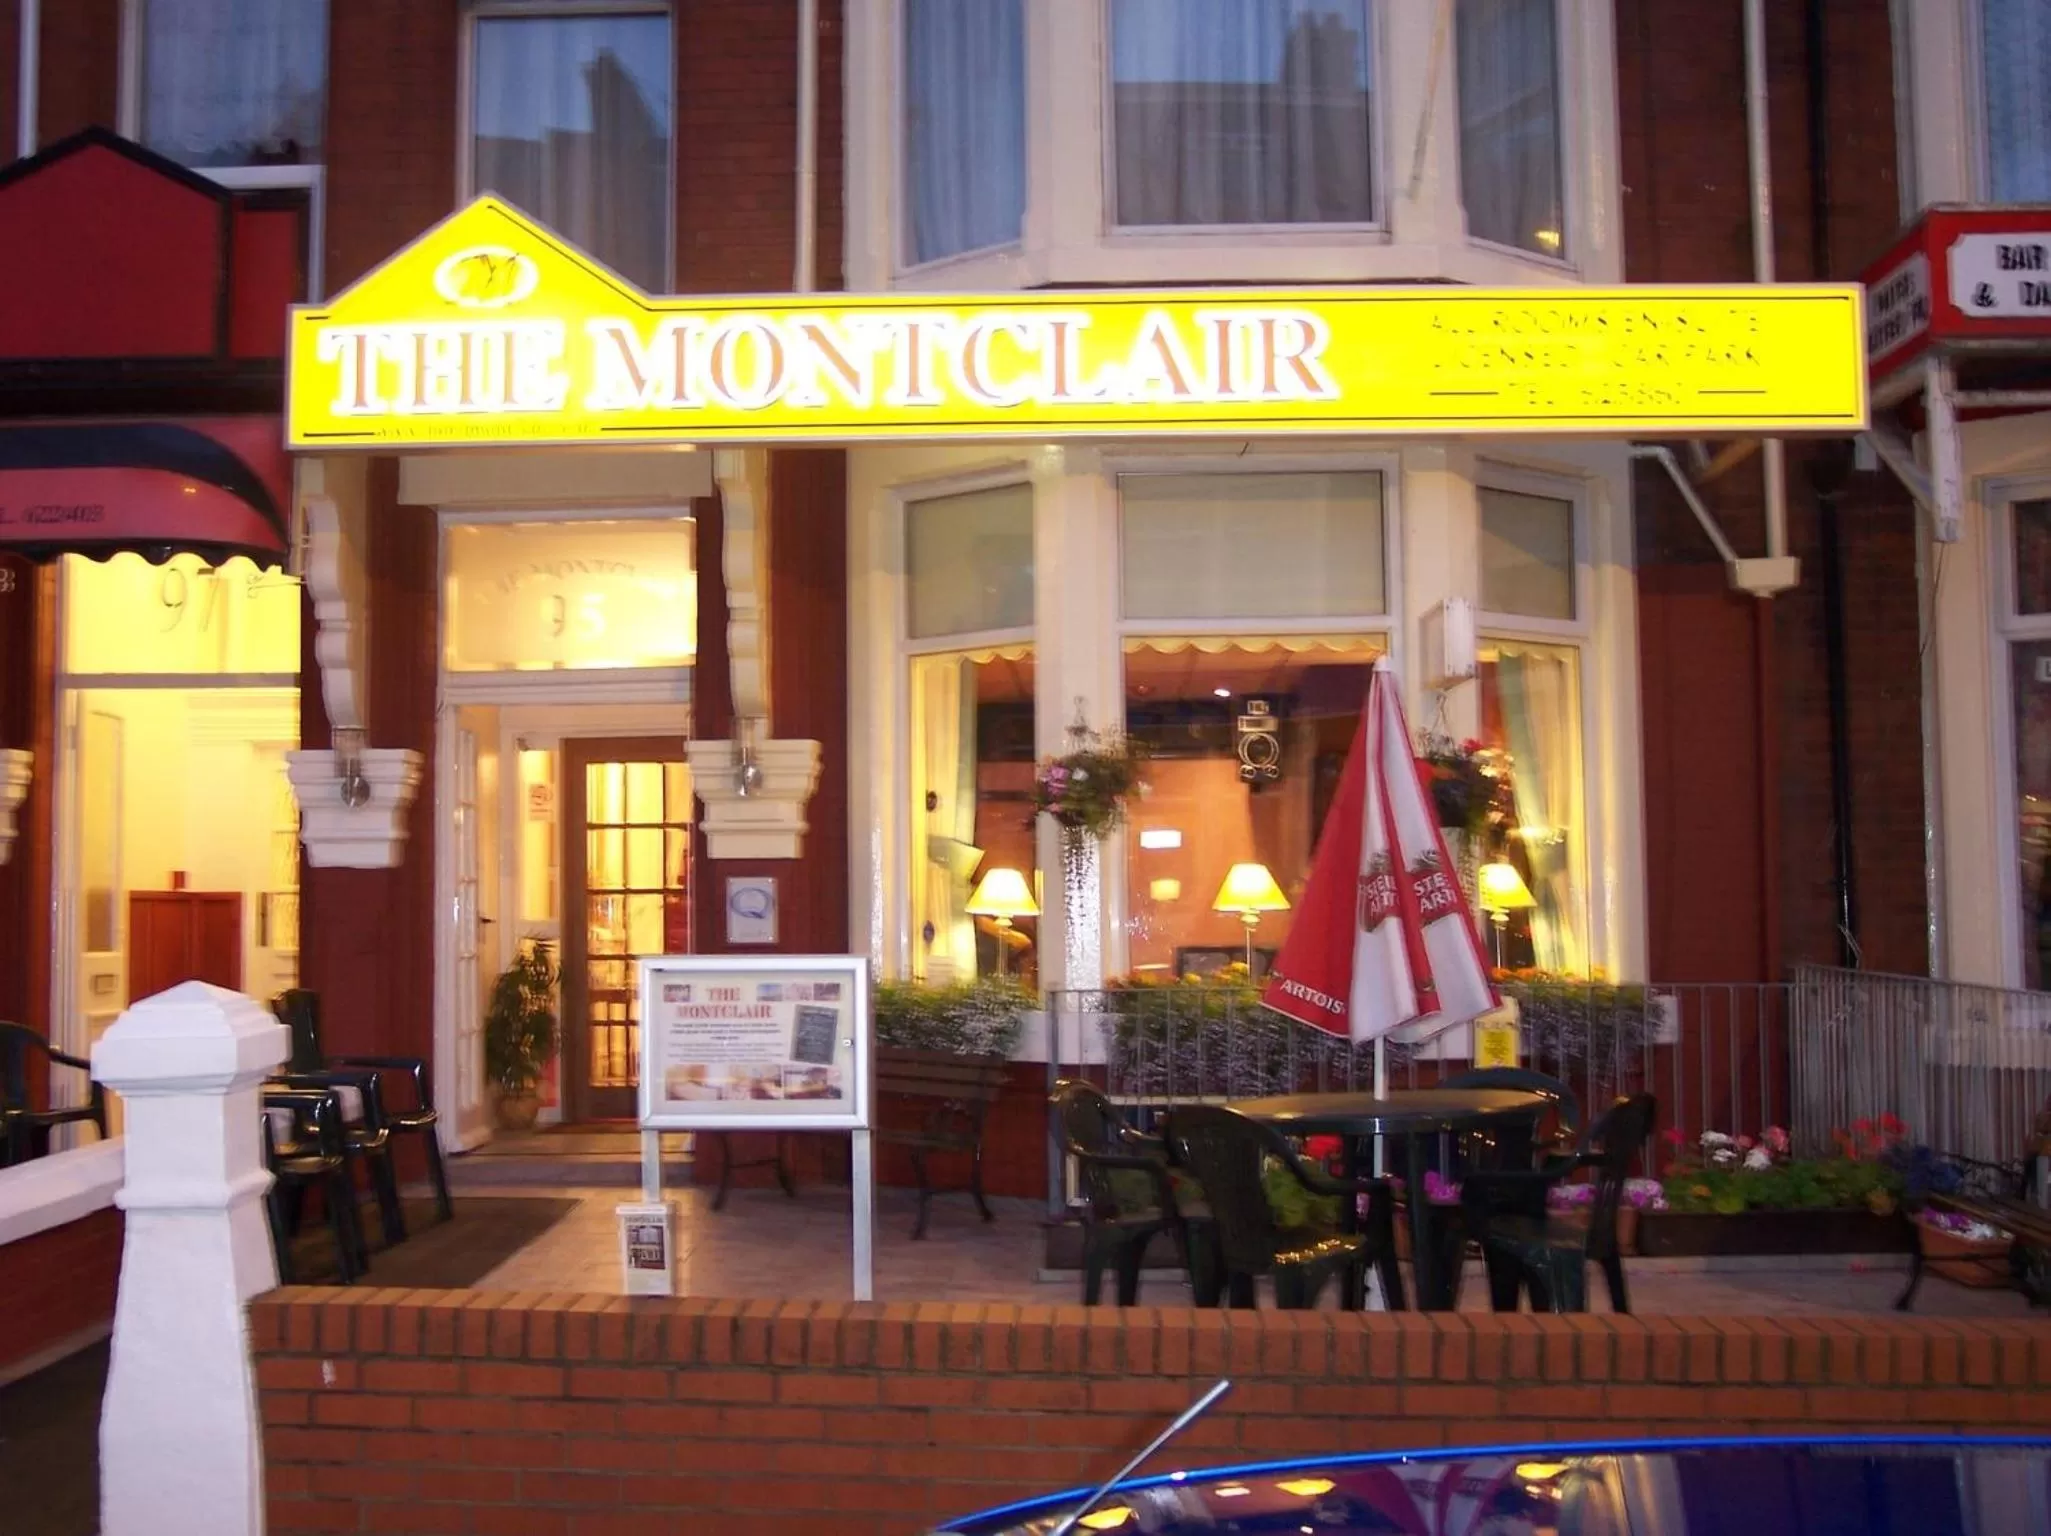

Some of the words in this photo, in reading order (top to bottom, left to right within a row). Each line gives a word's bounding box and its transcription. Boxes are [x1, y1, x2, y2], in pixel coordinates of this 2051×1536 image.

[320, 322, 567, 414] THE
[592, 310, 1342, 410] MONTCLAIR
[706, 987, 741, 1001] THE
[1280, 979, 1345, 1014] ARTOIS
[676, 1004, 774, 1019] MONTCLAIR
